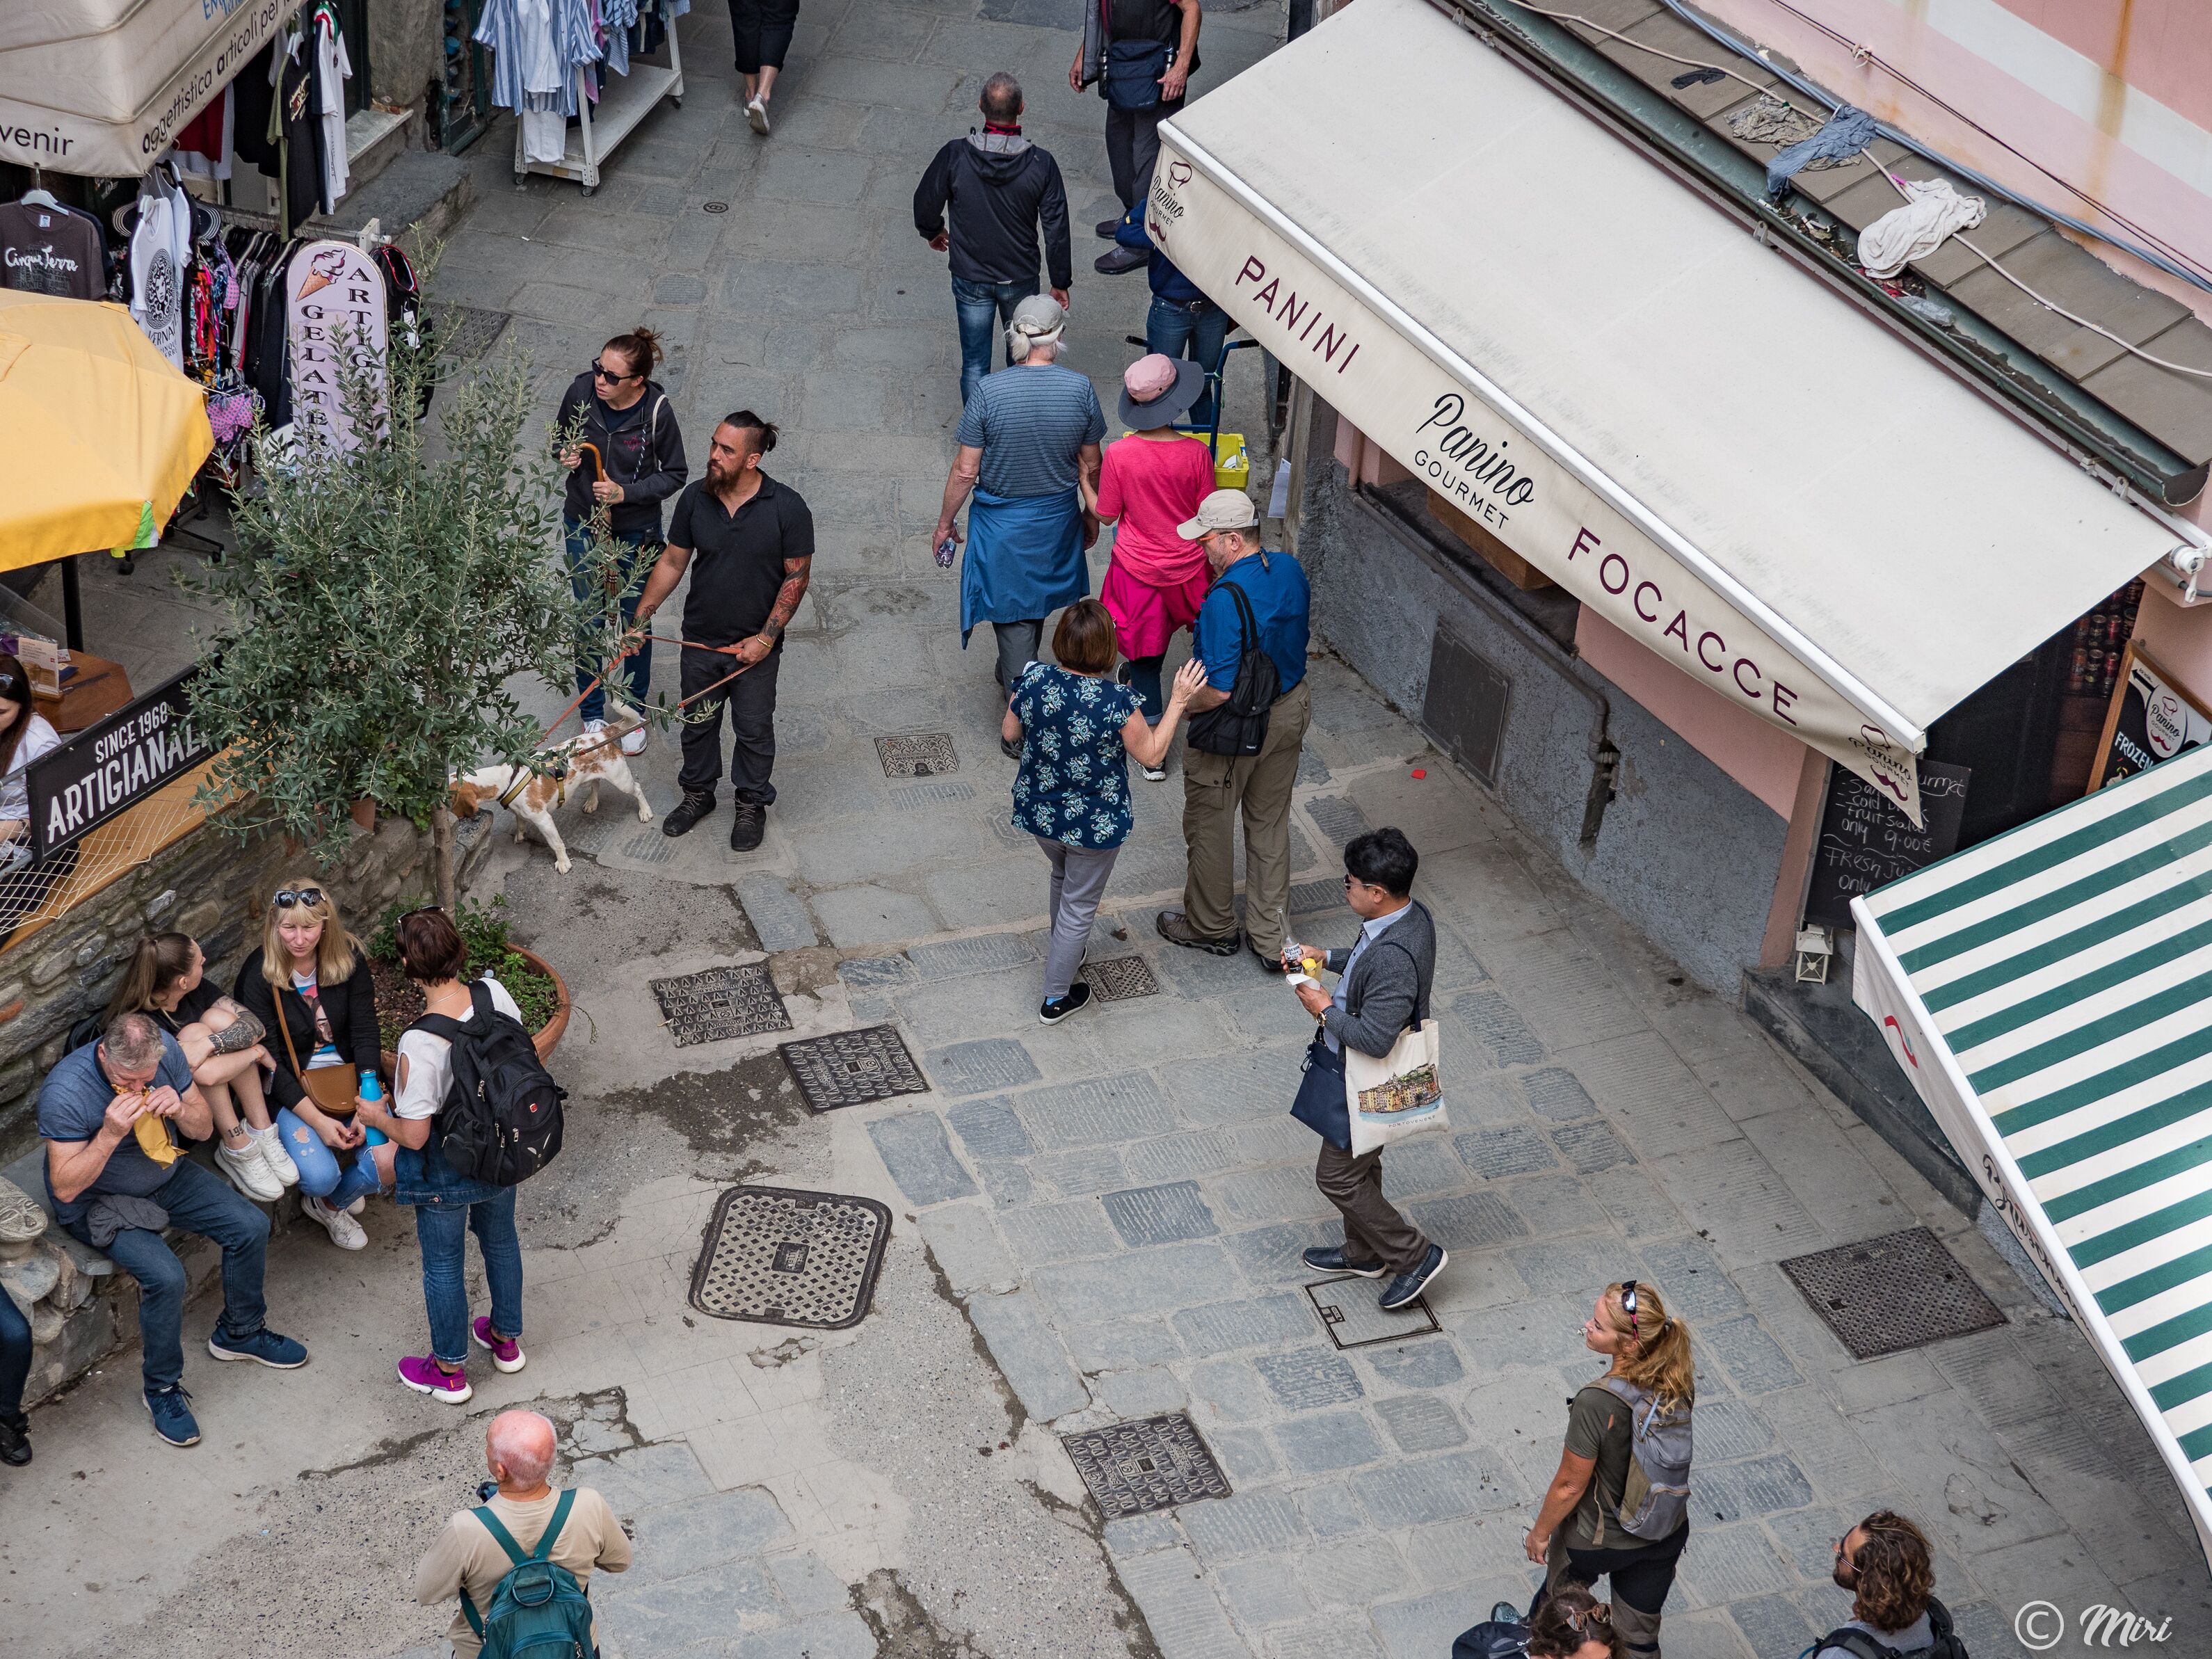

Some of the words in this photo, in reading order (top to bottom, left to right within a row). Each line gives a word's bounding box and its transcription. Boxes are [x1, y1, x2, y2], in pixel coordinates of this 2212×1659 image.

[143, 68, 212, 154] oggettistica
[217, 11, 257, 76] articoli
[1150, 175, 1184, 218] Panino
[1150, 200, 1174, 227] GOURMET
[6, 247, 44, 273] Cinque
[1235, 255, 1360, 374] PANINI
[1416, 393, 1534, 506] Panino
[1414, 450, 1509, 529] GOURMET
[1567, 526, 1799, 727] FOCACCE
[95, 720, 136, 763] SINCE
[138, 701, 168, 737] 1968
[2149, 704, 2181, 737] Panino
[1848, 737, 1912, 780] Panino
[2115, 731, 2154, 771] FROZEN
